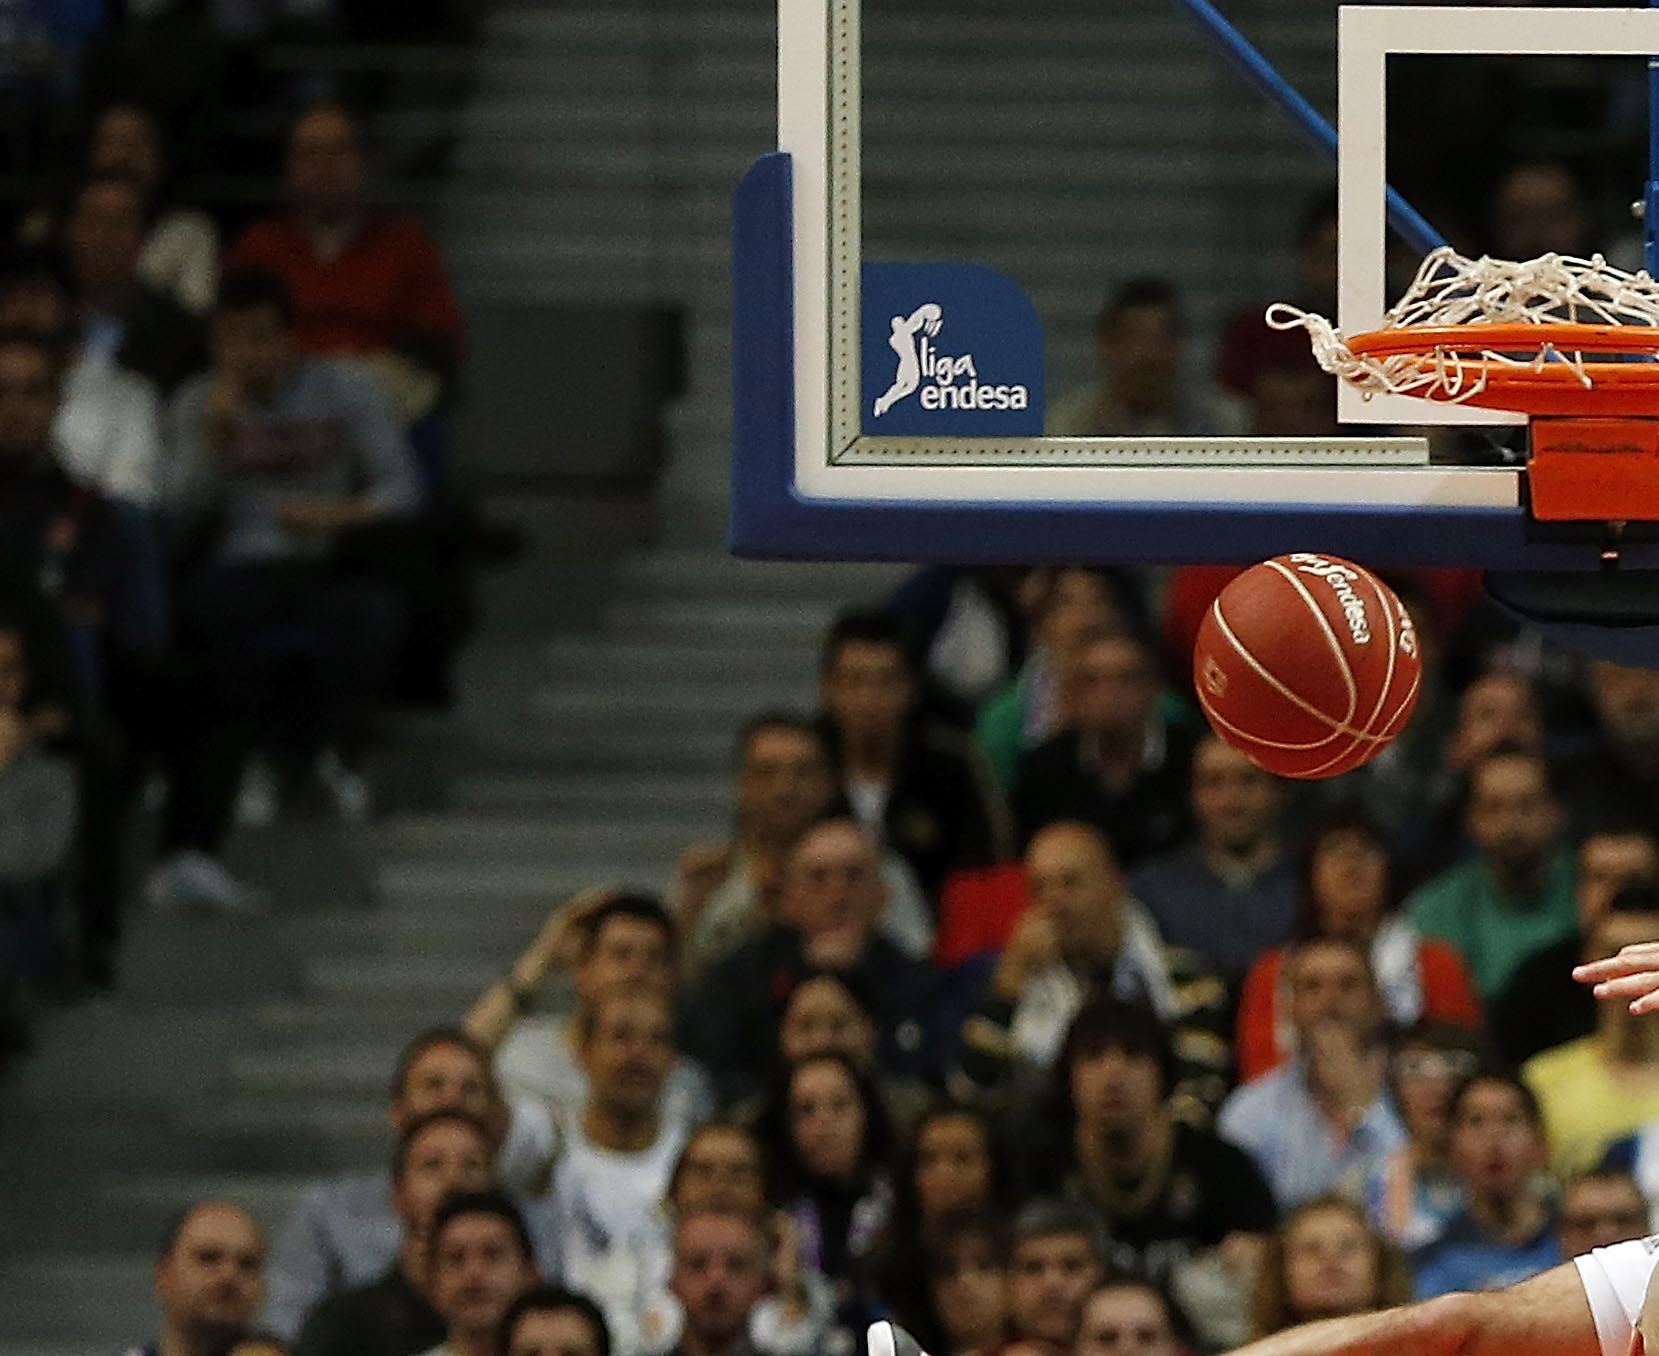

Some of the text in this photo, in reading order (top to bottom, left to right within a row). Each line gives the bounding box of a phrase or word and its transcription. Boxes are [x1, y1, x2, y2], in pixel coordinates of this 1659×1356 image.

[920, 336, 977, 386] liga
[920, 379, 1028, 410] endesa
[1326, 574, 1372, 645] endesa
